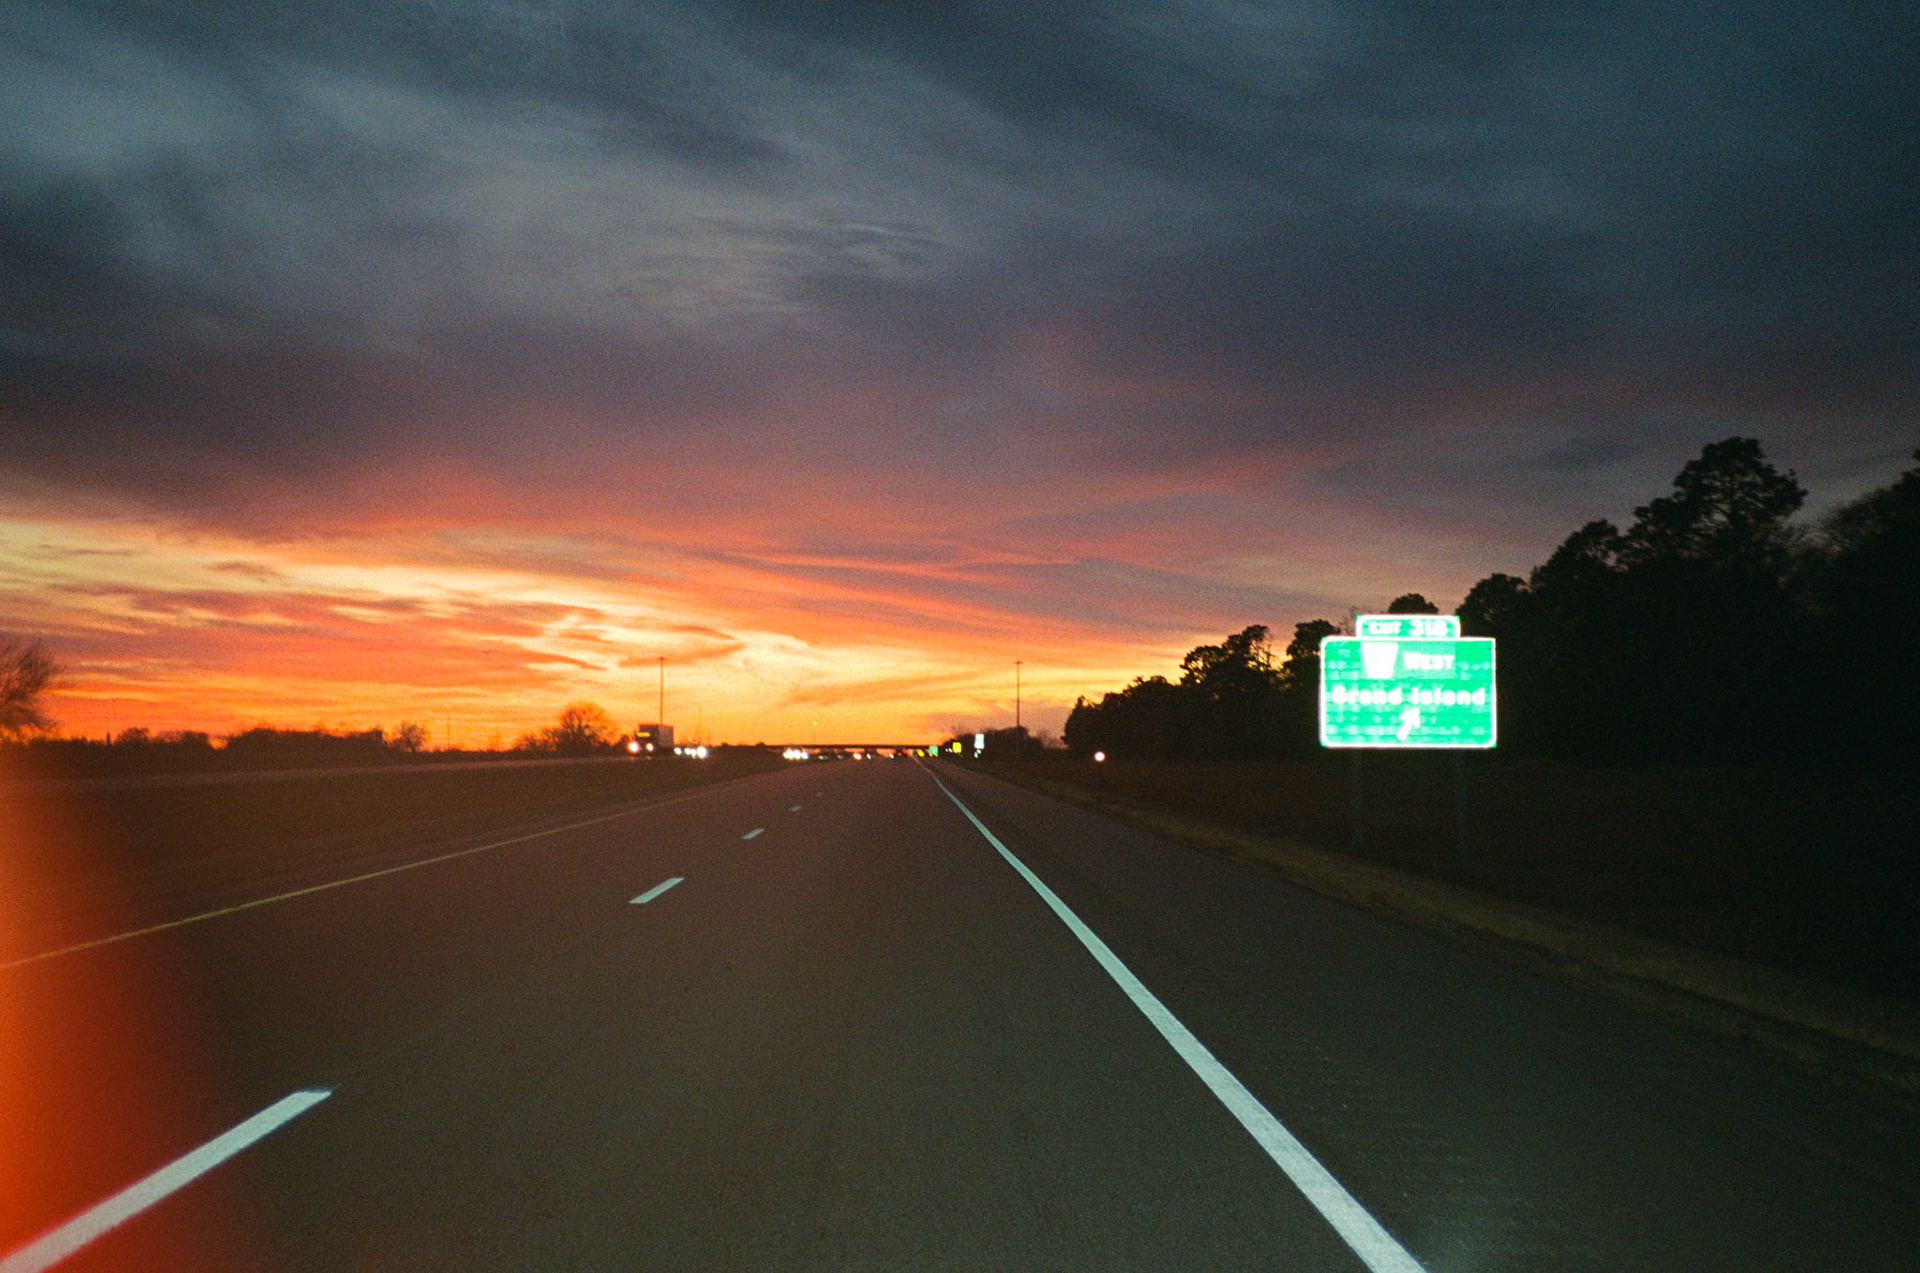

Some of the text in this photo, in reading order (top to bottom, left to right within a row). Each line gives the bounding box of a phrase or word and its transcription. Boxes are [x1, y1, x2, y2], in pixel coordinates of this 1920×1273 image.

[1368, 621, 1401, 635] EXIT
[1403, 652, 1454, 669] WEST
[1331, 685, 1486, 705] Grand Island
